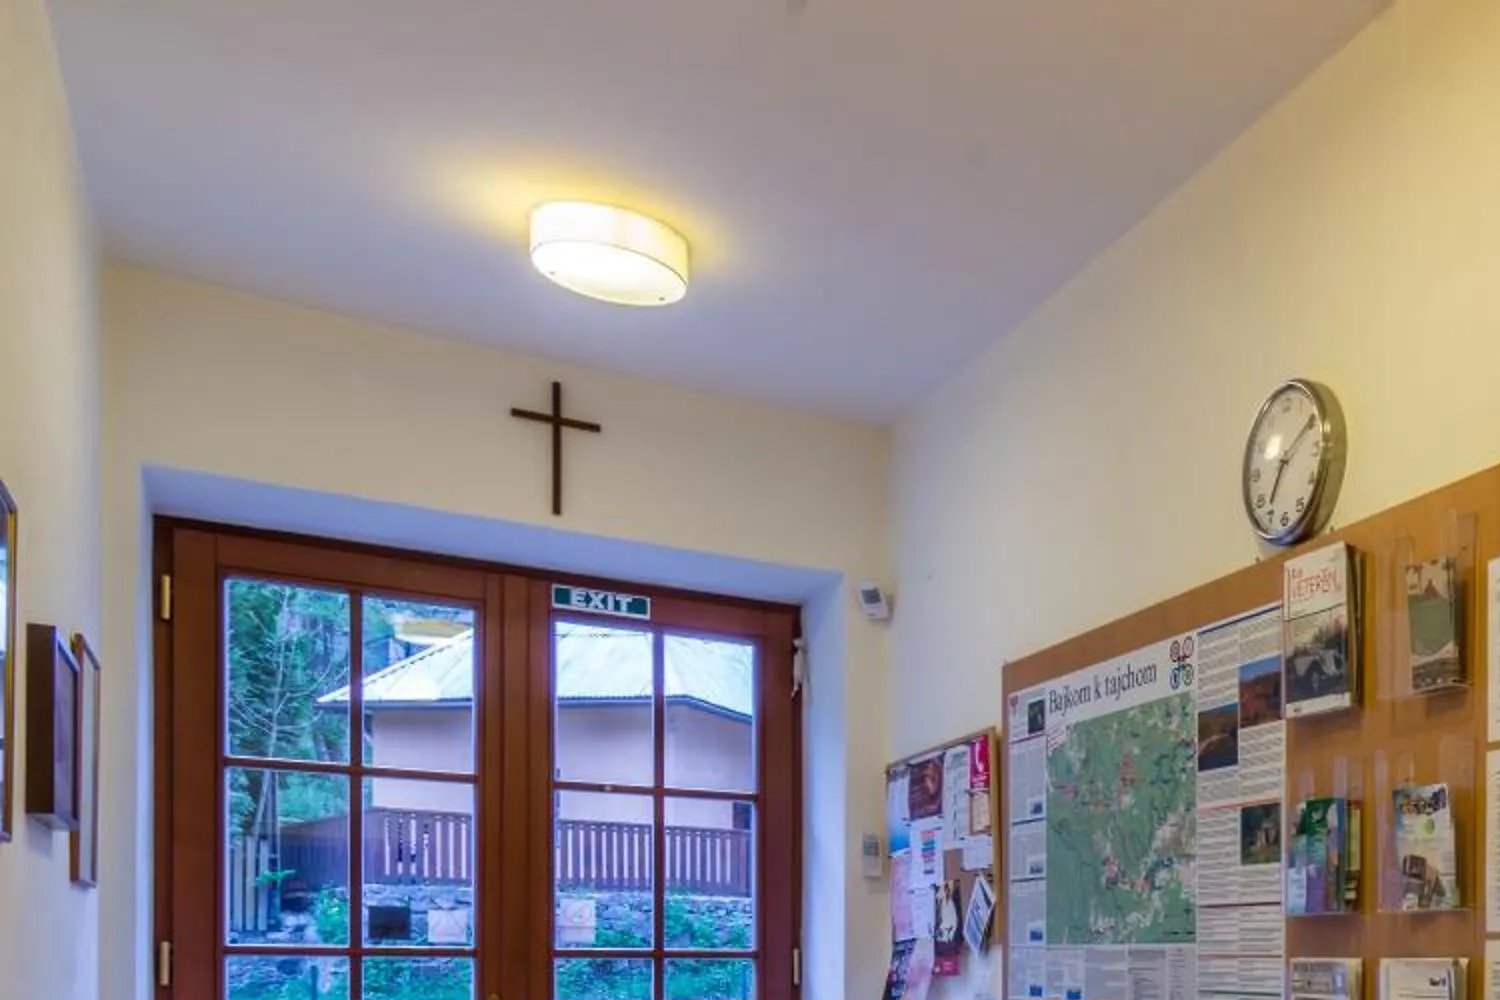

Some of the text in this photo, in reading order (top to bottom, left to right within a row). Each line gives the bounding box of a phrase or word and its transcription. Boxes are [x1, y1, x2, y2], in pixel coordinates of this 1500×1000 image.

[571, 590, 633, 612] EXIT
[1048, 662, 1157, 716] Bajkom k tajchom
